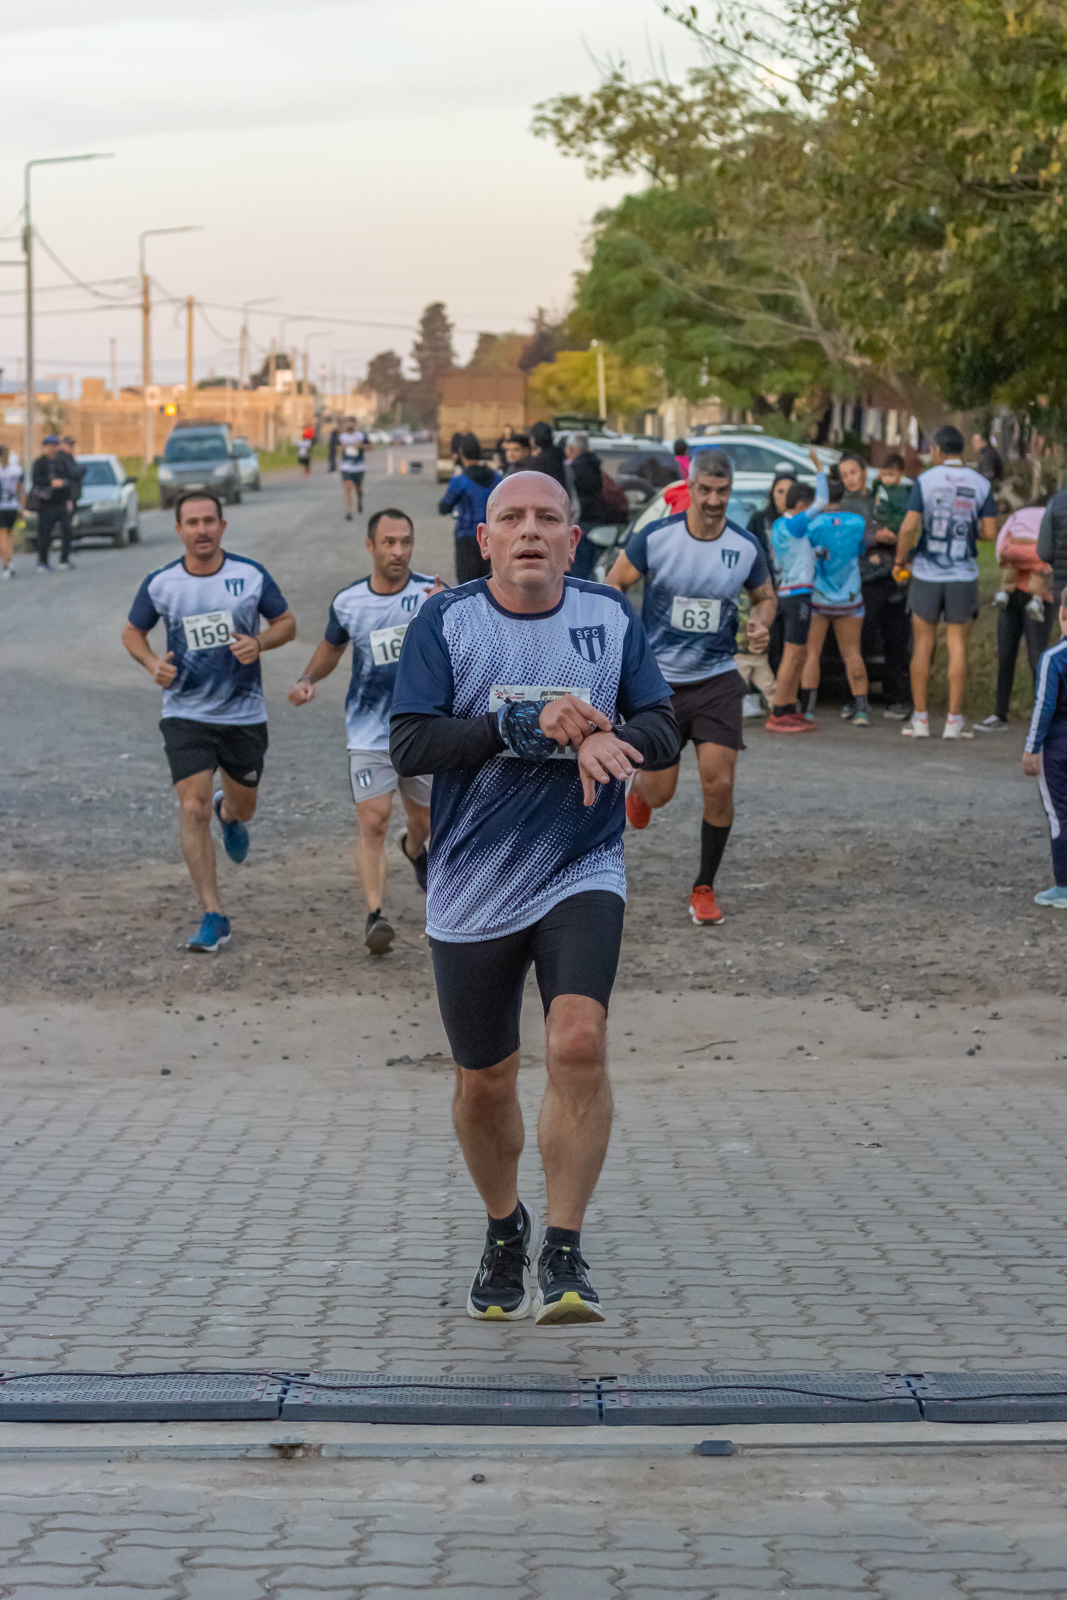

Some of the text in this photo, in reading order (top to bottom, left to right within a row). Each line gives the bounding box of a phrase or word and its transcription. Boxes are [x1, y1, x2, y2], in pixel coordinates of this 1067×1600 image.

[682, 609, 710, 630] 63
[189, 623, 230, 648] 159
[576, 628, 599, 639] SFC
